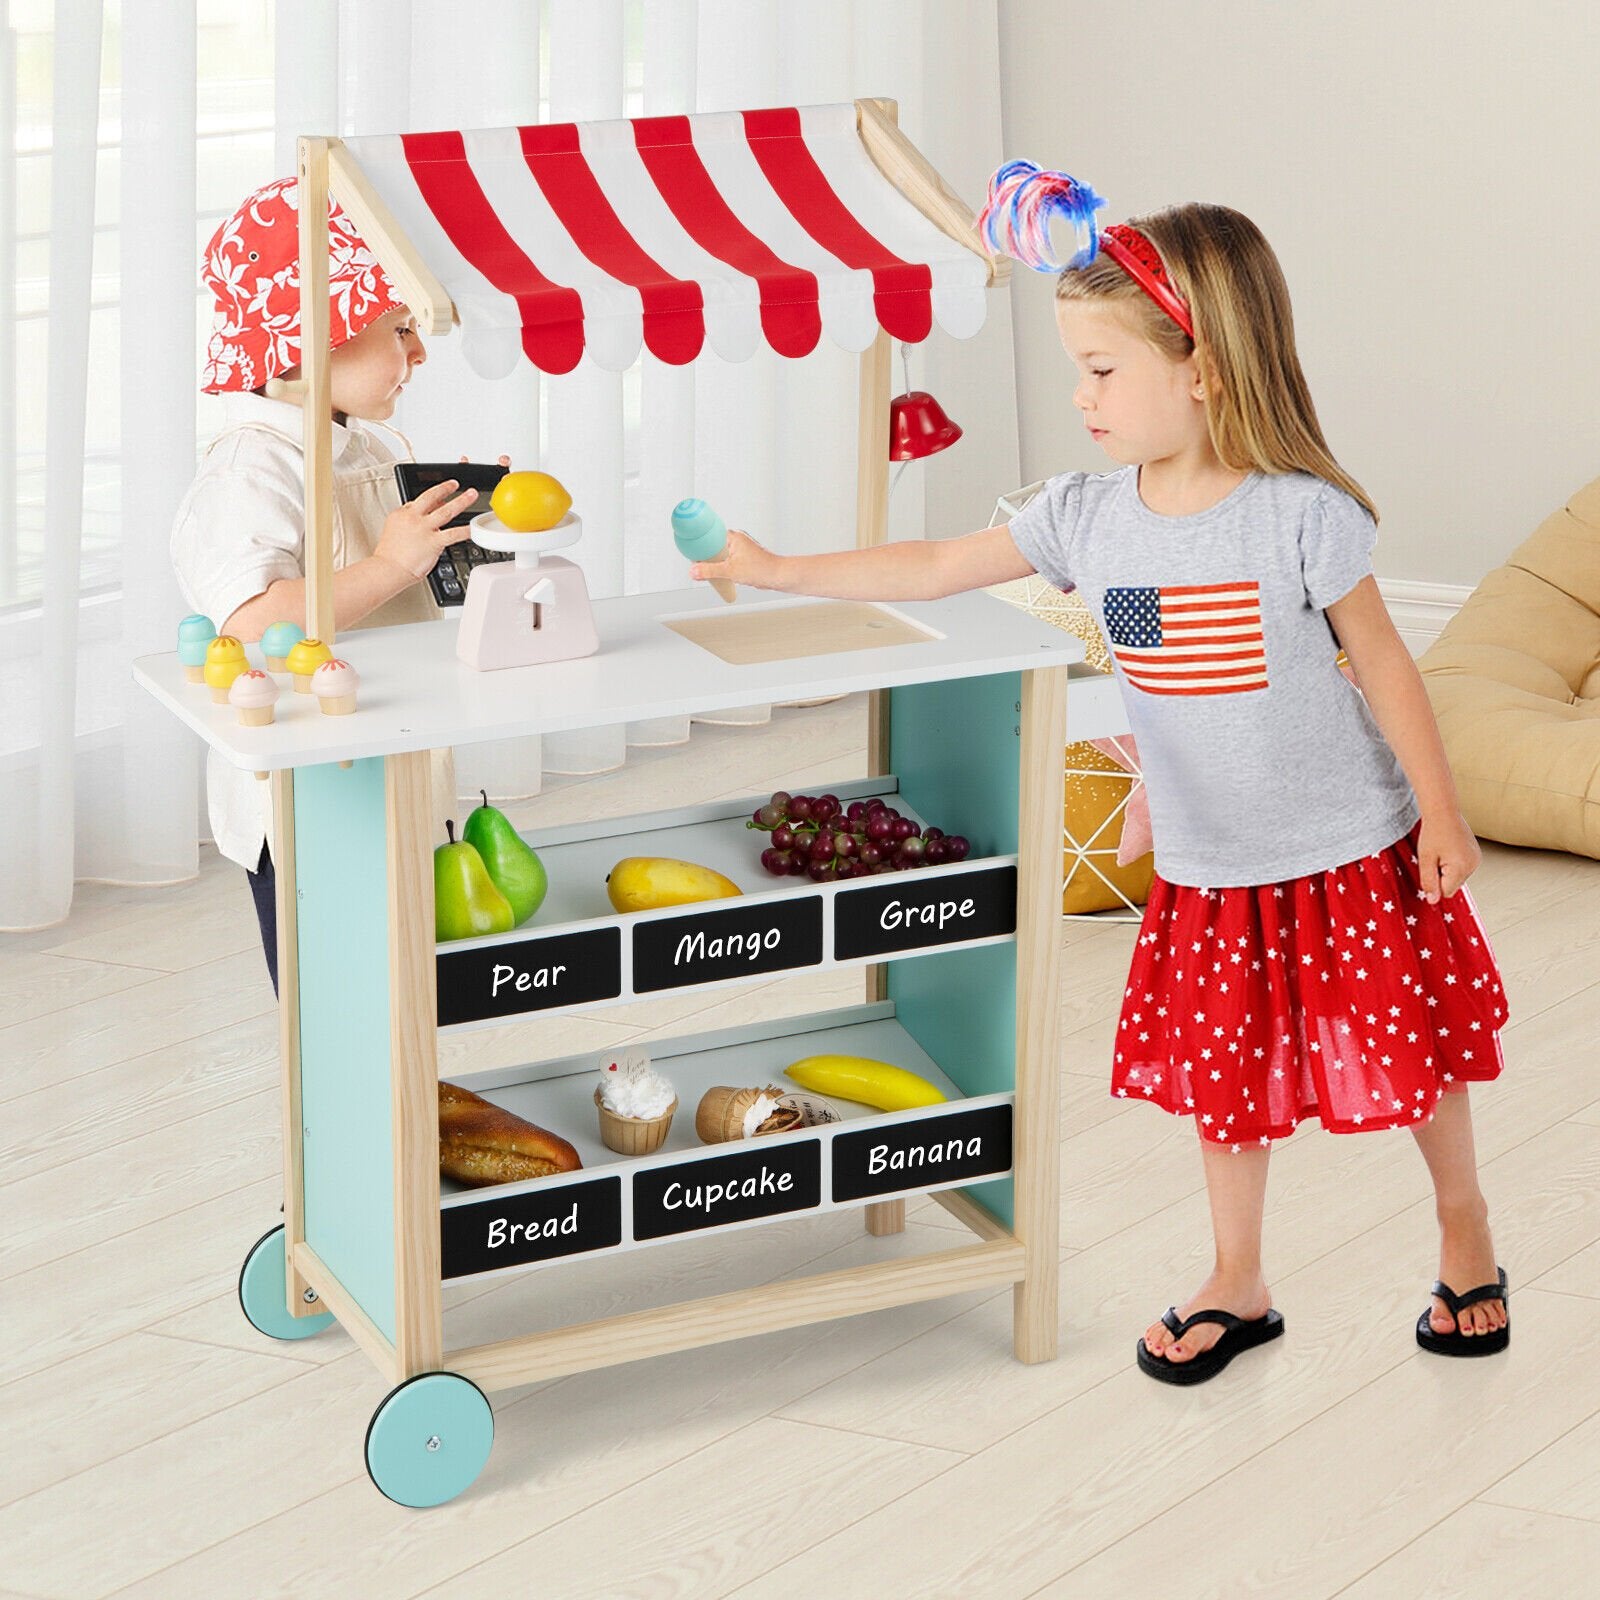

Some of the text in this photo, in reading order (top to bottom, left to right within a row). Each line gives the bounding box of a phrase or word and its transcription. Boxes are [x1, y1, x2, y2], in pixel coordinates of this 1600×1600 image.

[880, 899, 976, 931] Grape
[674, 928, 781, 966] Mango
[492, 964, 567, 998] Pear
[869, 1137, 982, 1175] Banana
[663, 1167, 794, 1213] Cupcake
[487, 1203, 578, 1249] Bread
